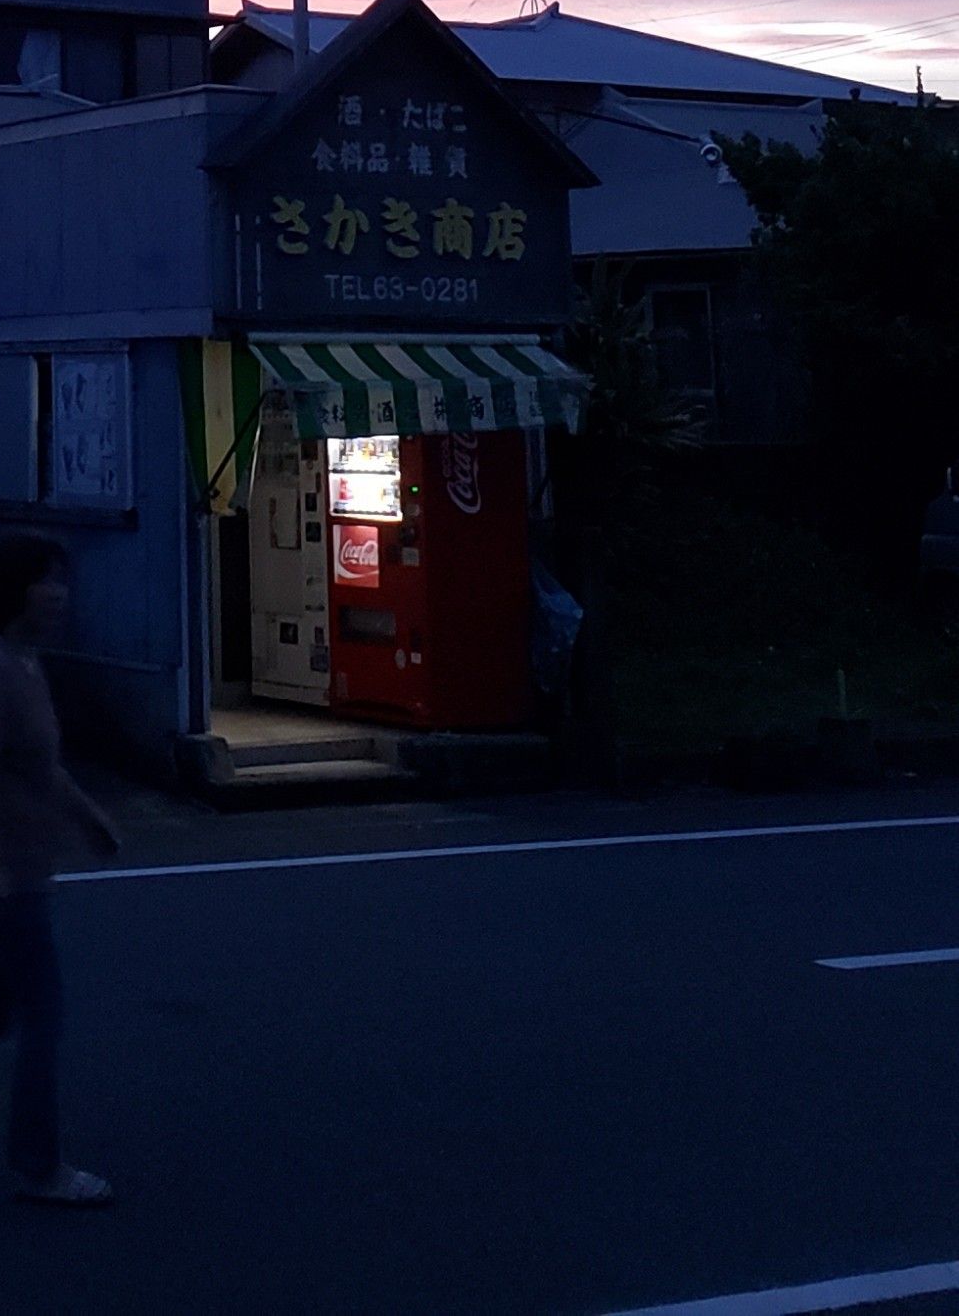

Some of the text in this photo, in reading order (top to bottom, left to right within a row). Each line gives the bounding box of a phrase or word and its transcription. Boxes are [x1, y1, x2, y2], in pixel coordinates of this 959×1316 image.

[269, 192, 529, 263] さかき商店
